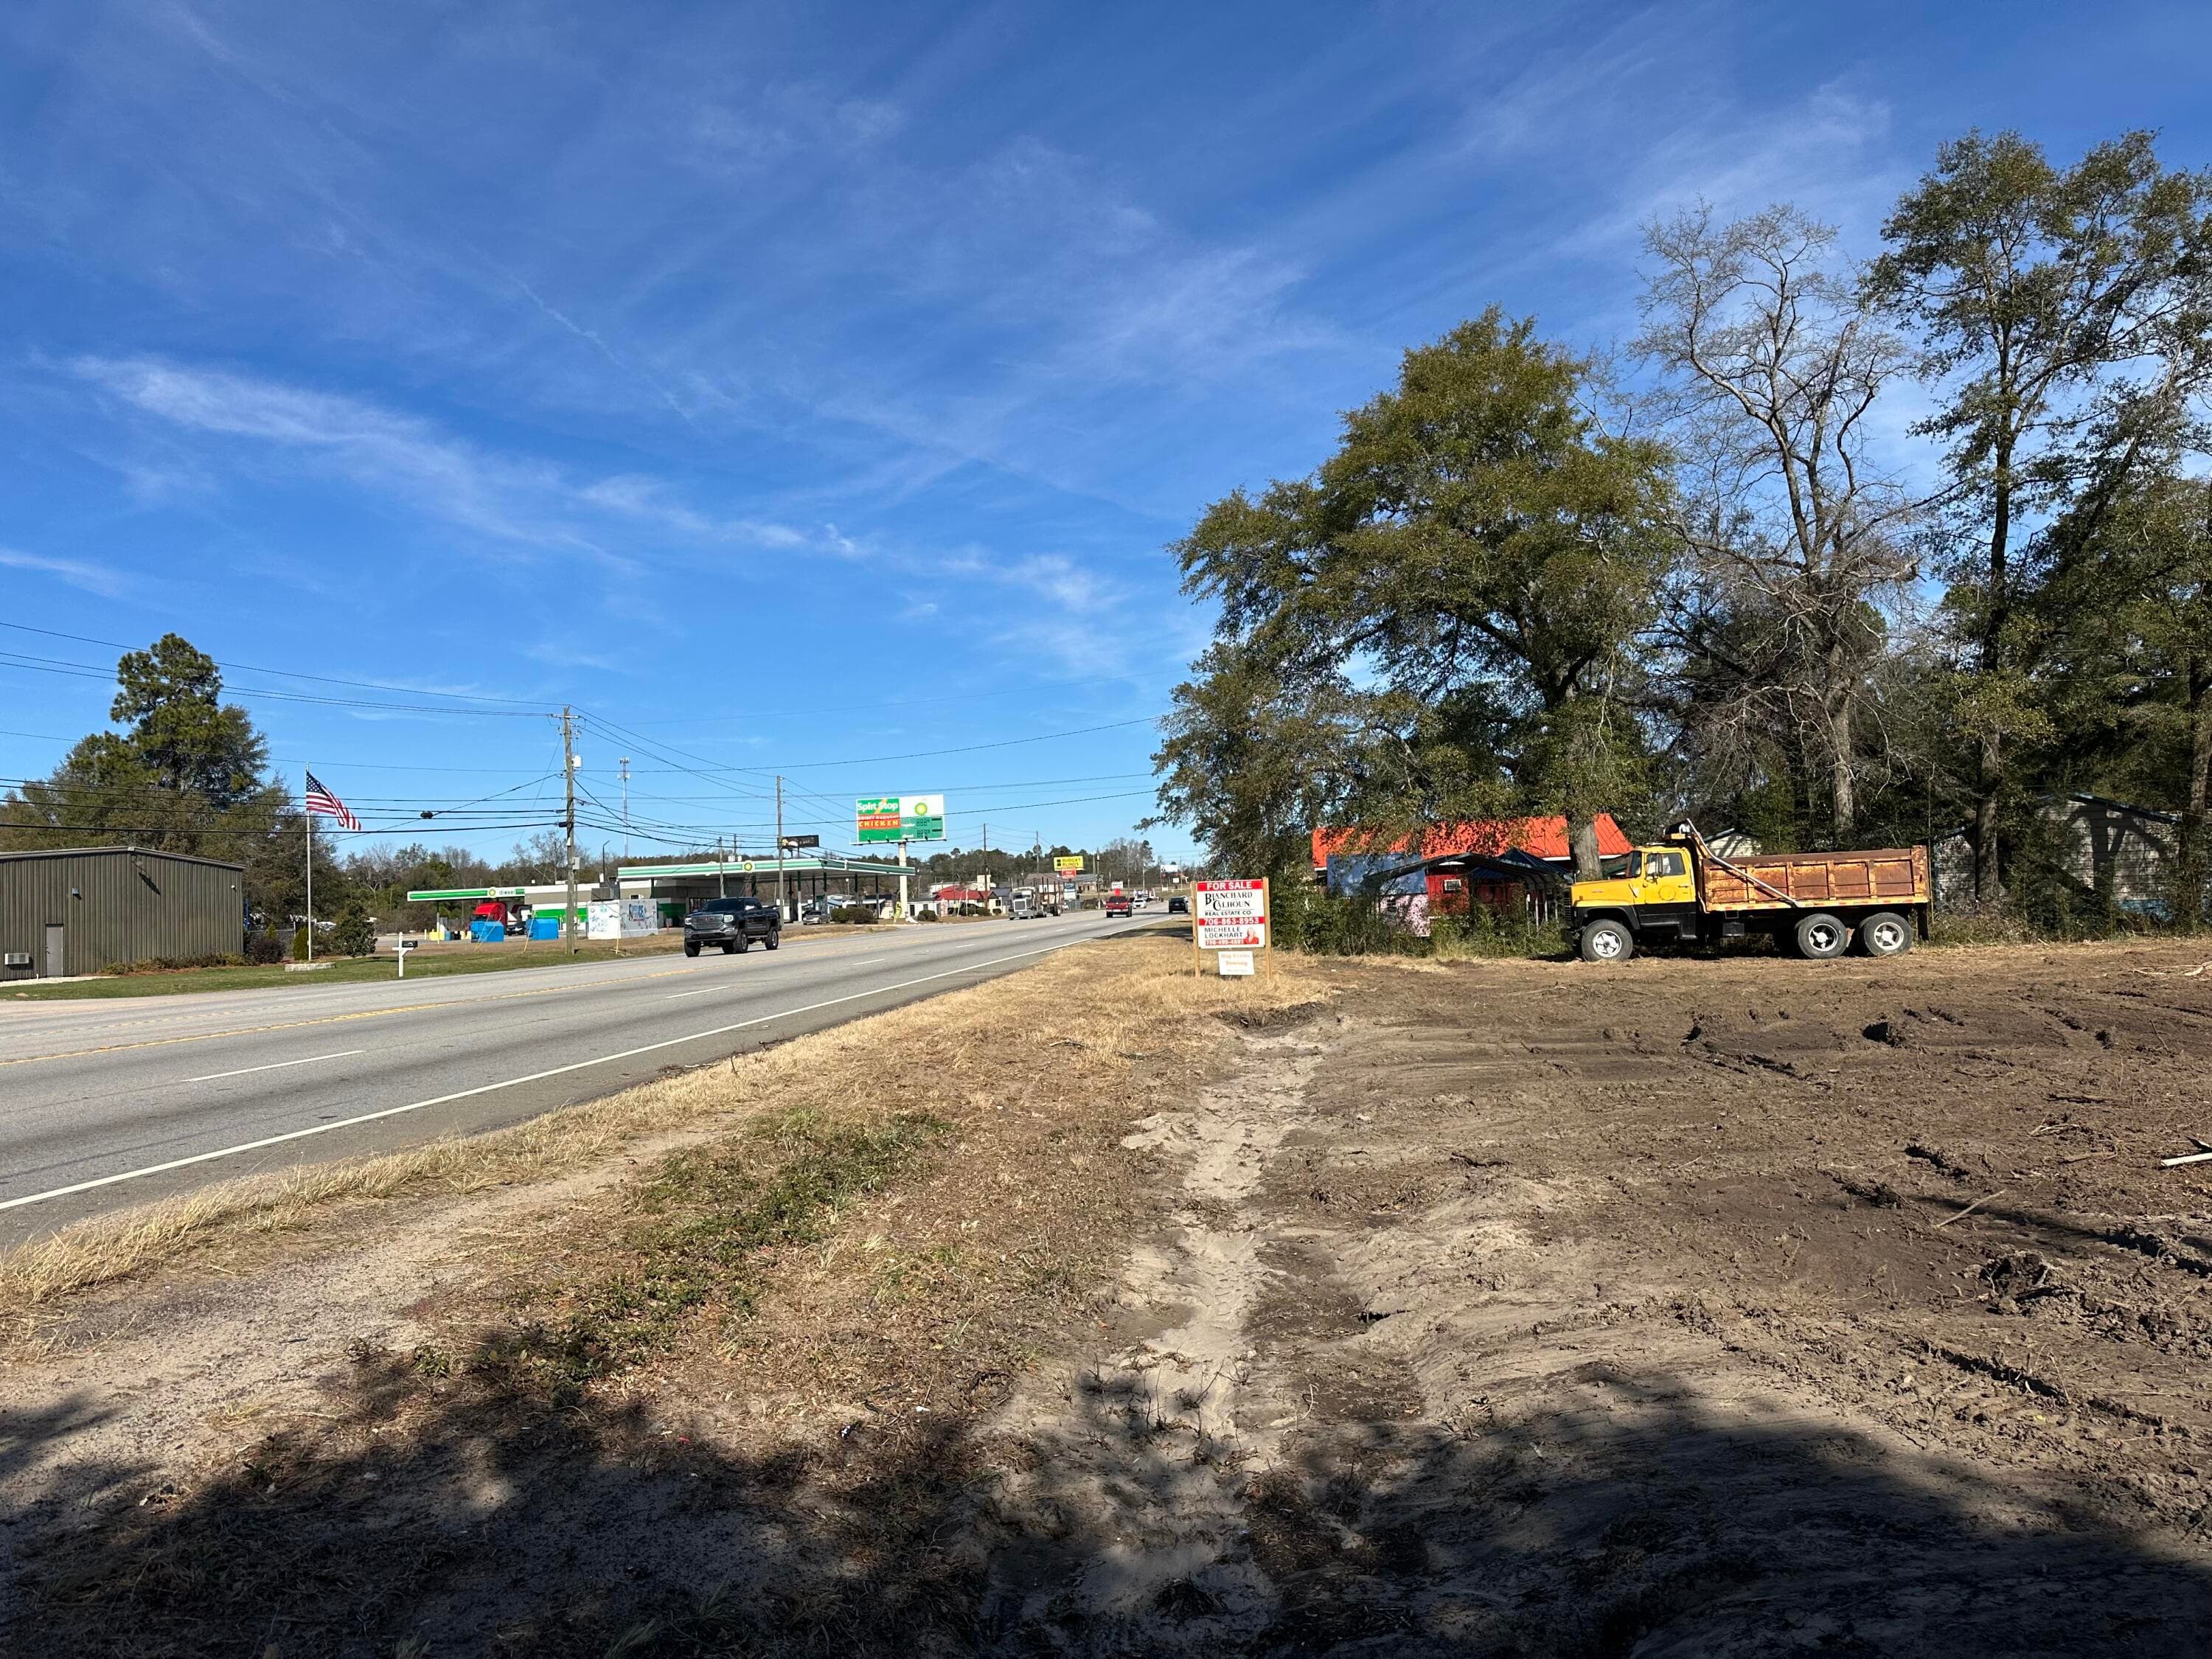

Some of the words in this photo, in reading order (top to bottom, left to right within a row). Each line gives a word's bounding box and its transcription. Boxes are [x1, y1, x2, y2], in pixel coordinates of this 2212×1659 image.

[1228, 881, 1252, 889] SALE
[1205, 891, 1253, 905] BLANCHARD
[1213, 900, 1250, 911] CALHOUN
[1205, 917, 1259, 925] 706-863-8953
